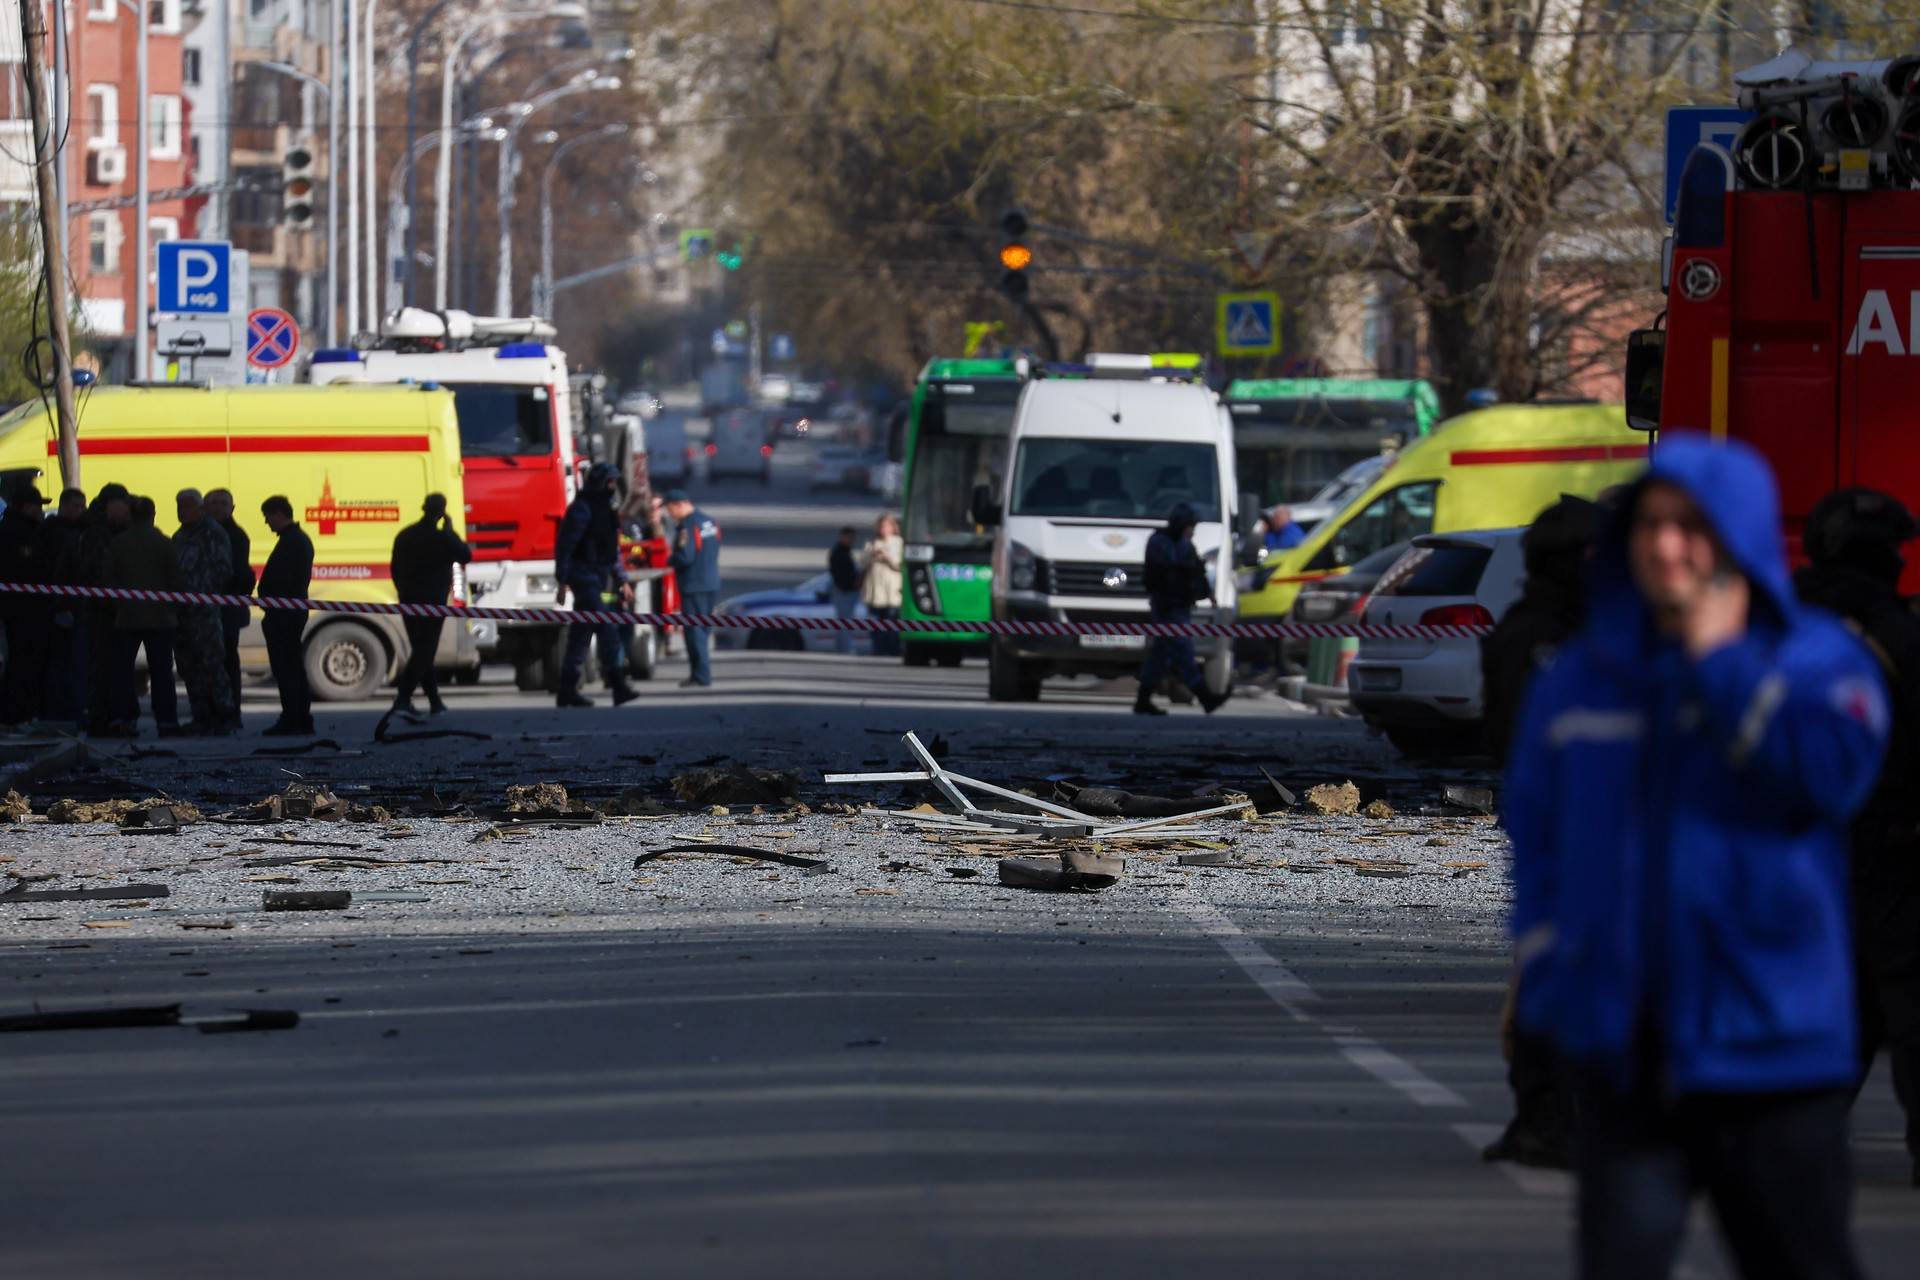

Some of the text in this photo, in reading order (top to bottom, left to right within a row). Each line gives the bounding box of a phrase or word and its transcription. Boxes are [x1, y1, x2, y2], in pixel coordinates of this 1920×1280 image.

[177, 248, 218, 308] P
[306, 509, 398, 520] СКОРАЯ ПОМОЩЬ
